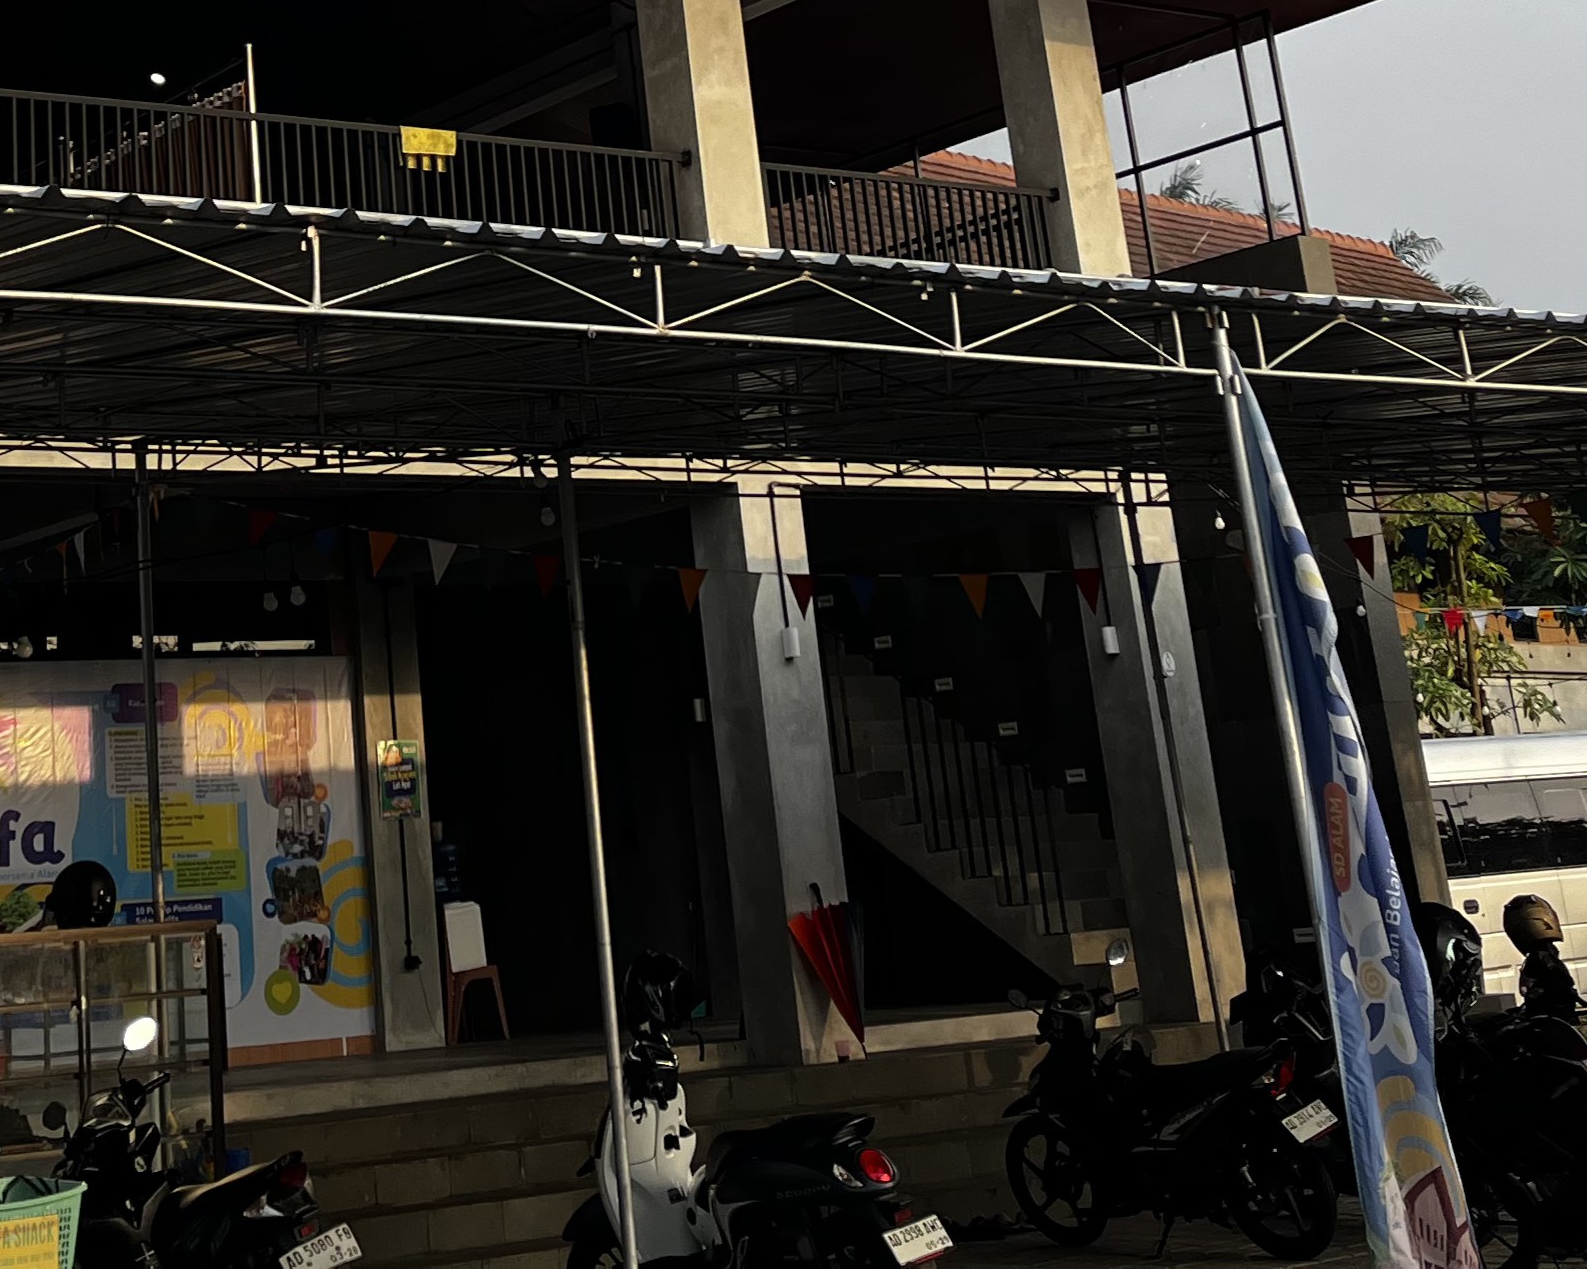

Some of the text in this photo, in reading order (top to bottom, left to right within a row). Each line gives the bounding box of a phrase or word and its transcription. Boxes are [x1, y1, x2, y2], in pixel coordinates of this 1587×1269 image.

[1329, 796, 1346, 850] ALAM
[286, 1251, 304, 1269] AD
[303, 1234, 334, 1258] 5080
